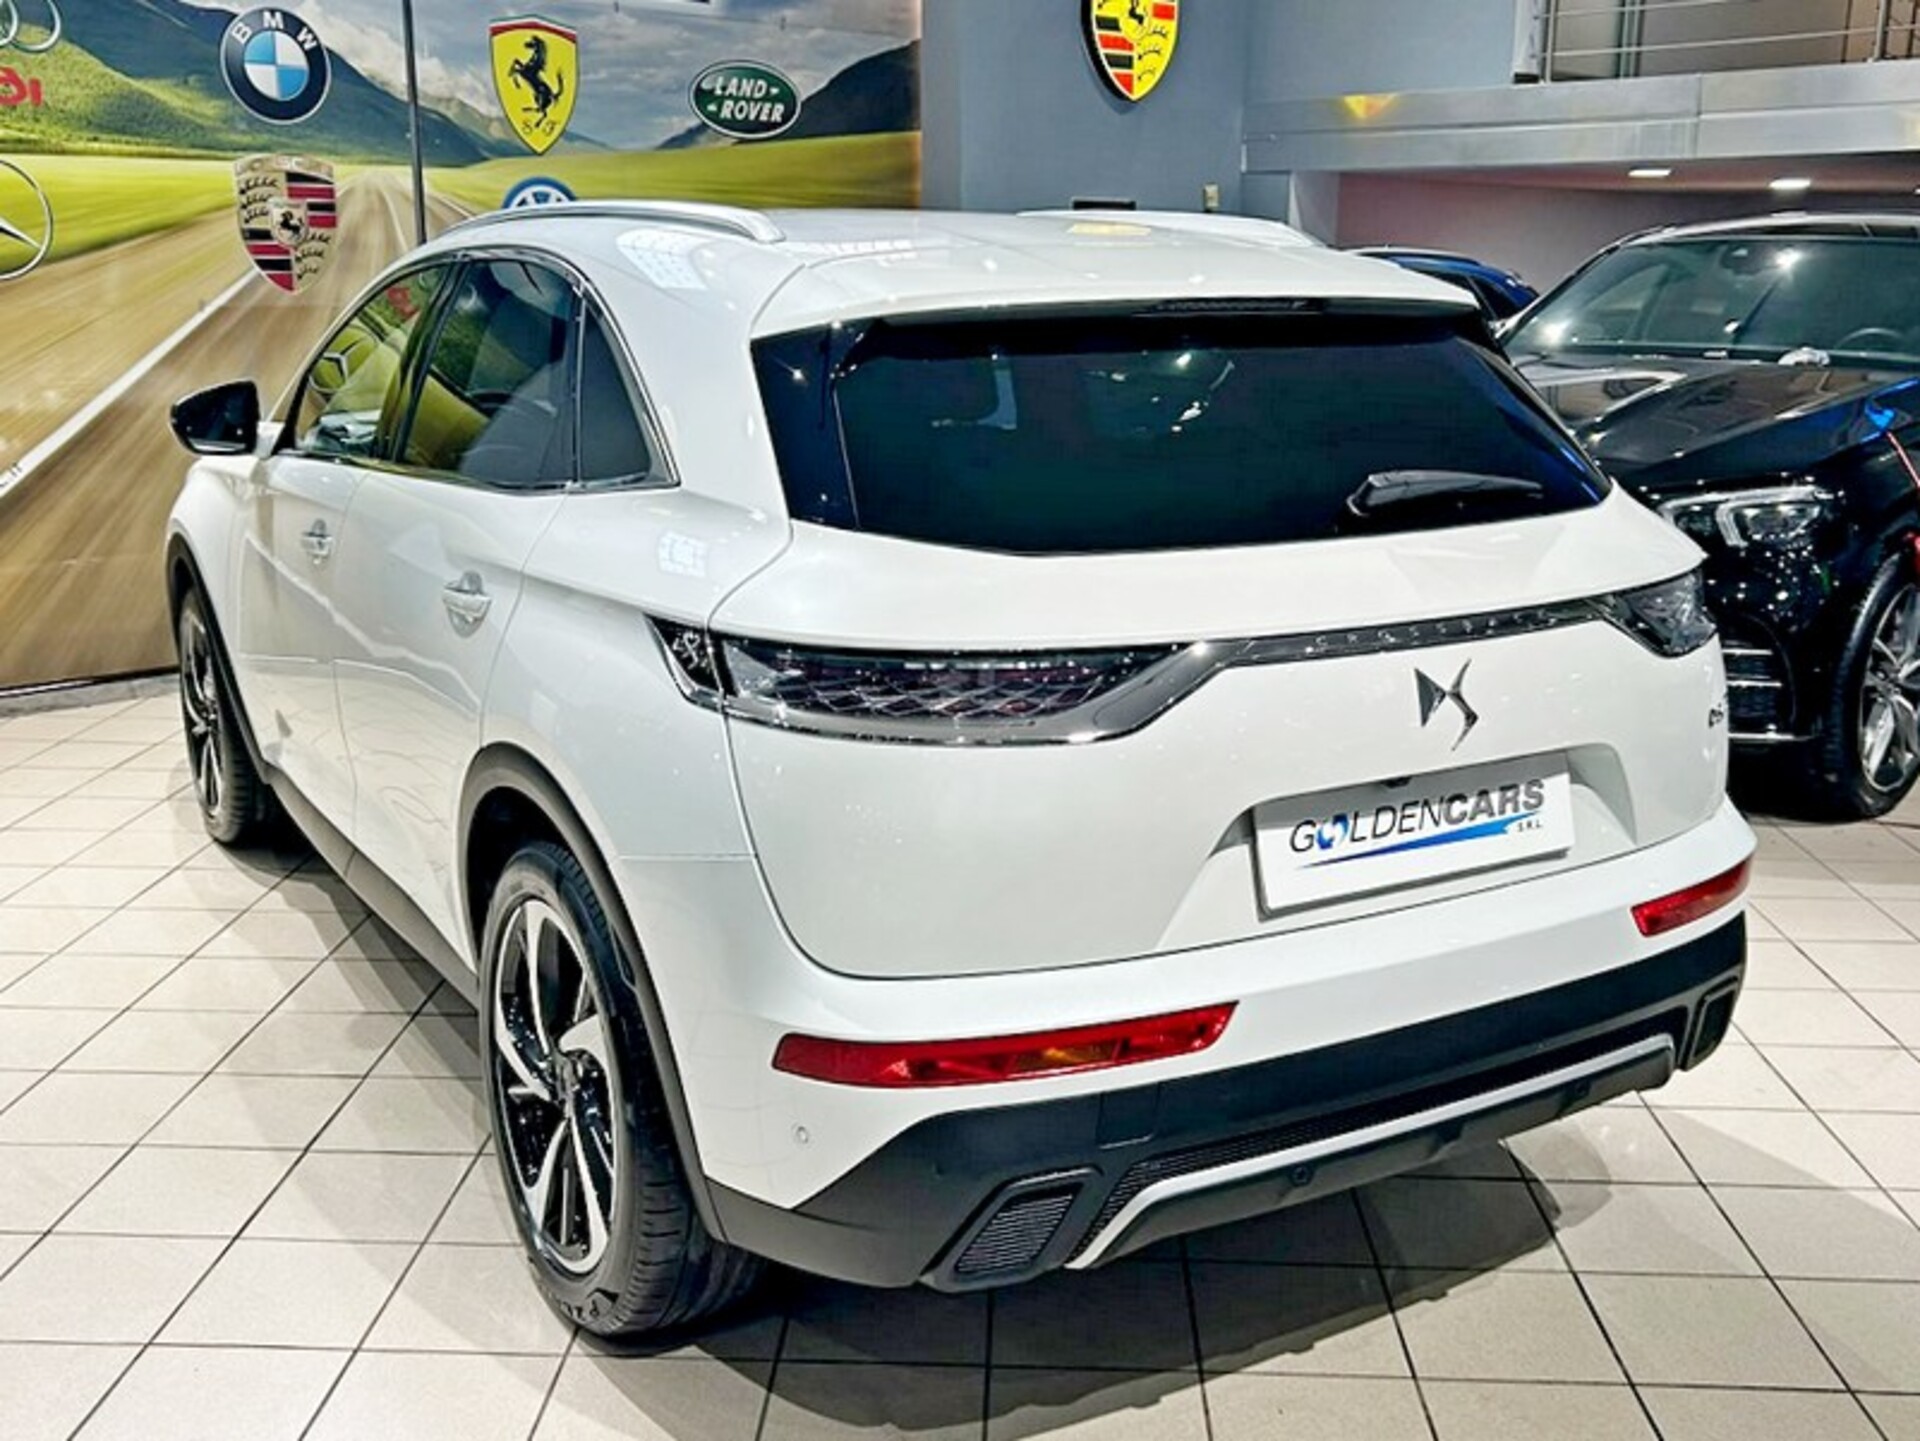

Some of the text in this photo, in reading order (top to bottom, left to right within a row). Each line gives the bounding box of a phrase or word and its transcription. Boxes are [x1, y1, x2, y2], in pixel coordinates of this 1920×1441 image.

[231, 9, 318, 51] BMW
[714, 76, 767, 98] LAND
[720, 100, 785, 122] ROVER
[1289, 779, 1544, 852] GOLDENCARS
